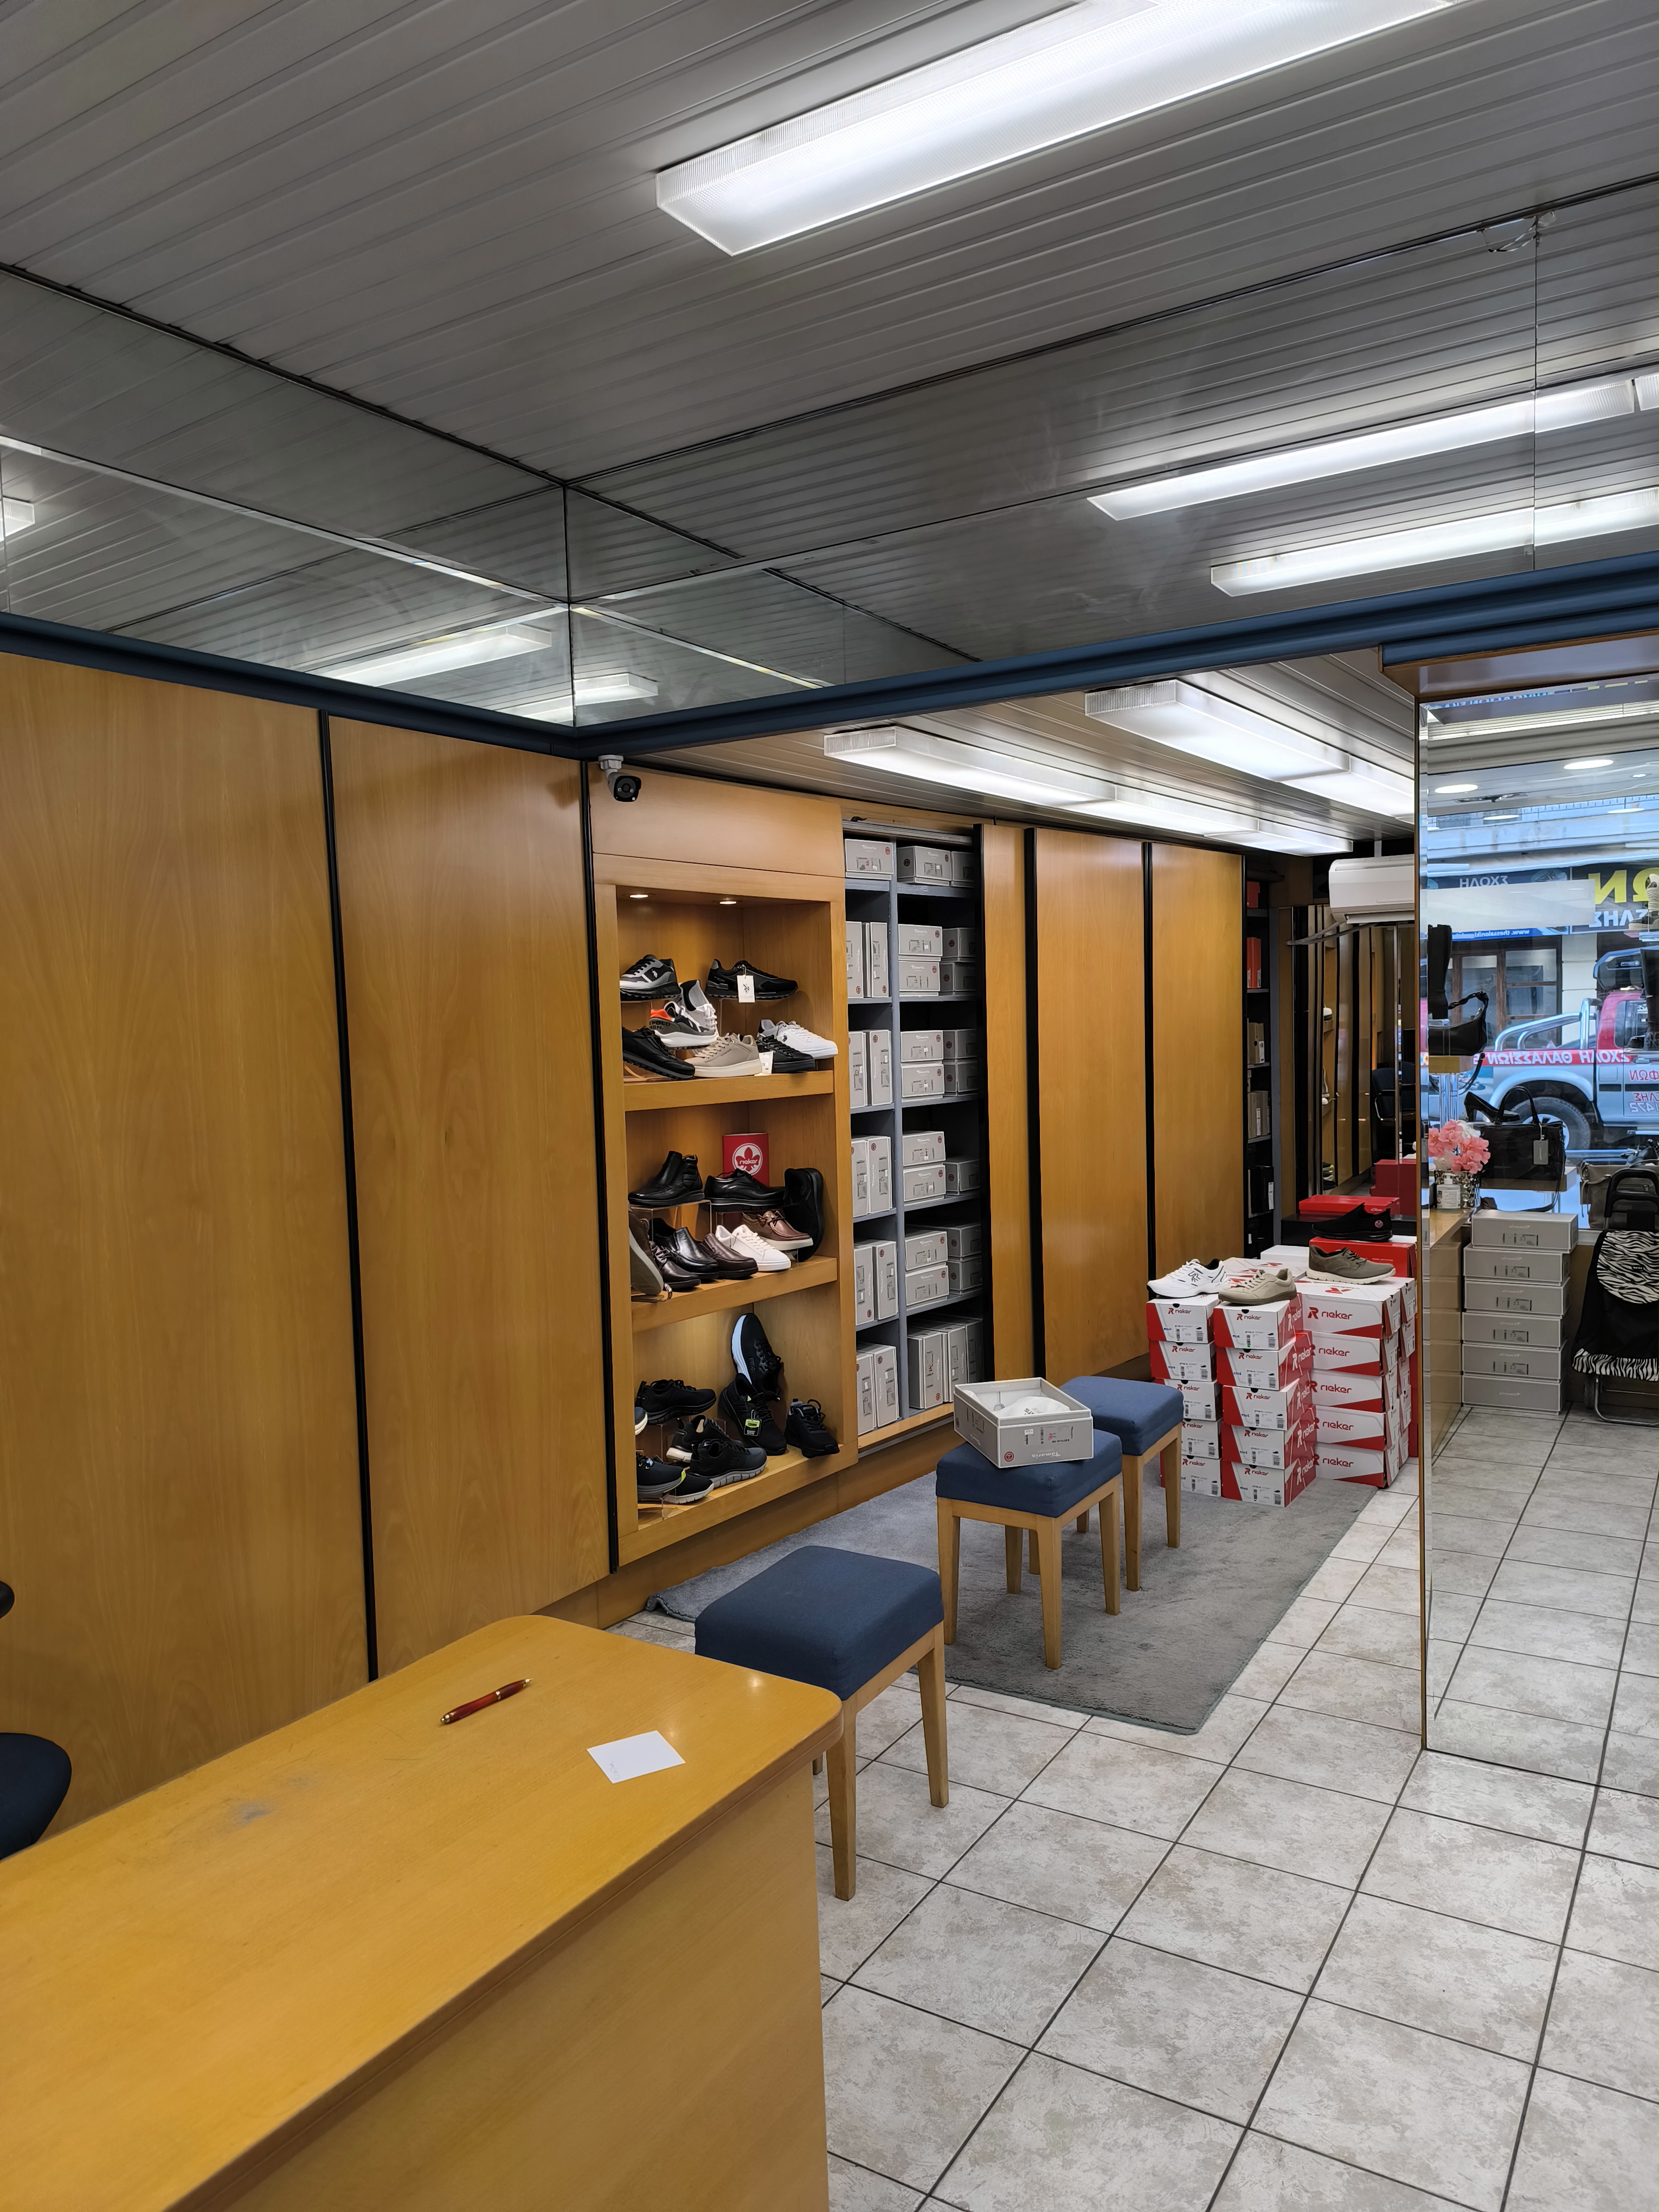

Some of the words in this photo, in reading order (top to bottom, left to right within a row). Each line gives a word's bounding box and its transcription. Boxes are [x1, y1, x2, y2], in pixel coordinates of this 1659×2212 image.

[1322, 1310, 1353, 1320] rieker
[1319, 1347, 1350, 1356] rieker
[1320, 1384, 1352, 1393] rieker
[1323, 1421, 1354, 1430] rieker
[1323, 1457, 1354, 1467] rieker
